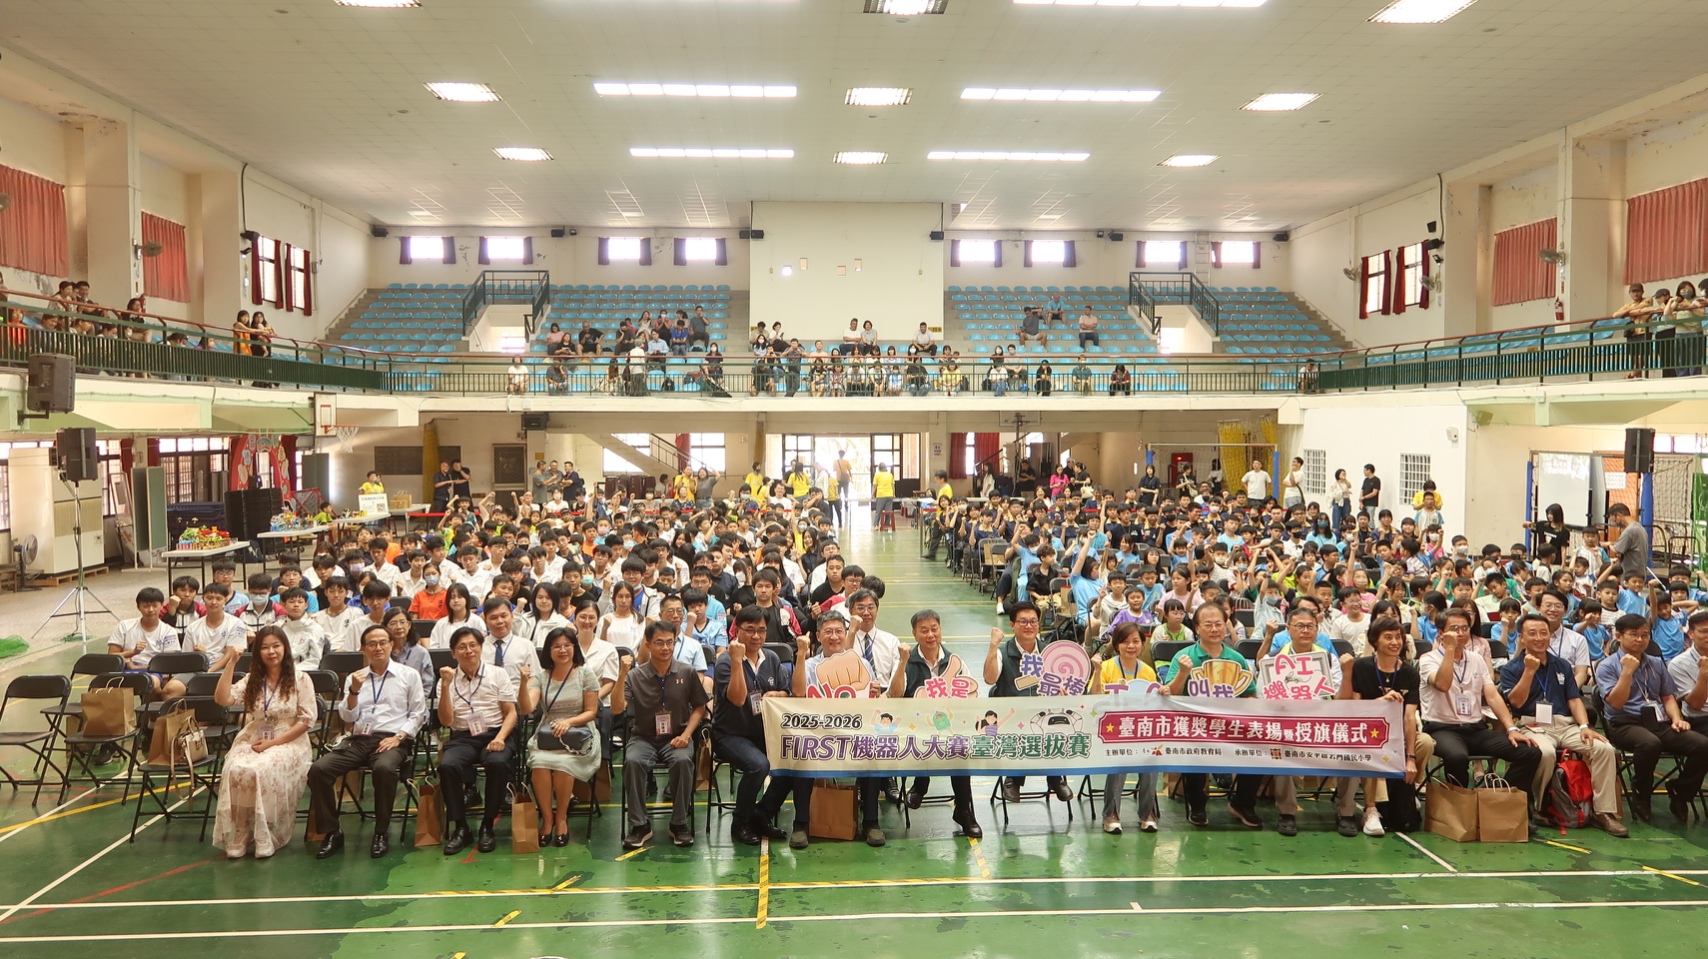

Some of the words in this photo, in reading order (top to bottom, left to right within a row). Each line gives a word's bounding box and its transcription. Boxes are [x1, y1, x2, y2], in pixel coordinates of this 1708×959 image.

[1275, 654, 1313, 675] AI
[926, 678, 969, 698] 我是
[1189, 679, 1233, 697] 叫我
[1264, 676, 1335, 699] 機器人
[782, 714, 861, 729] 2025-2026
[1118, 715, 1368, 744] 臺南市獲獎學生表揚暨授旗儀式
